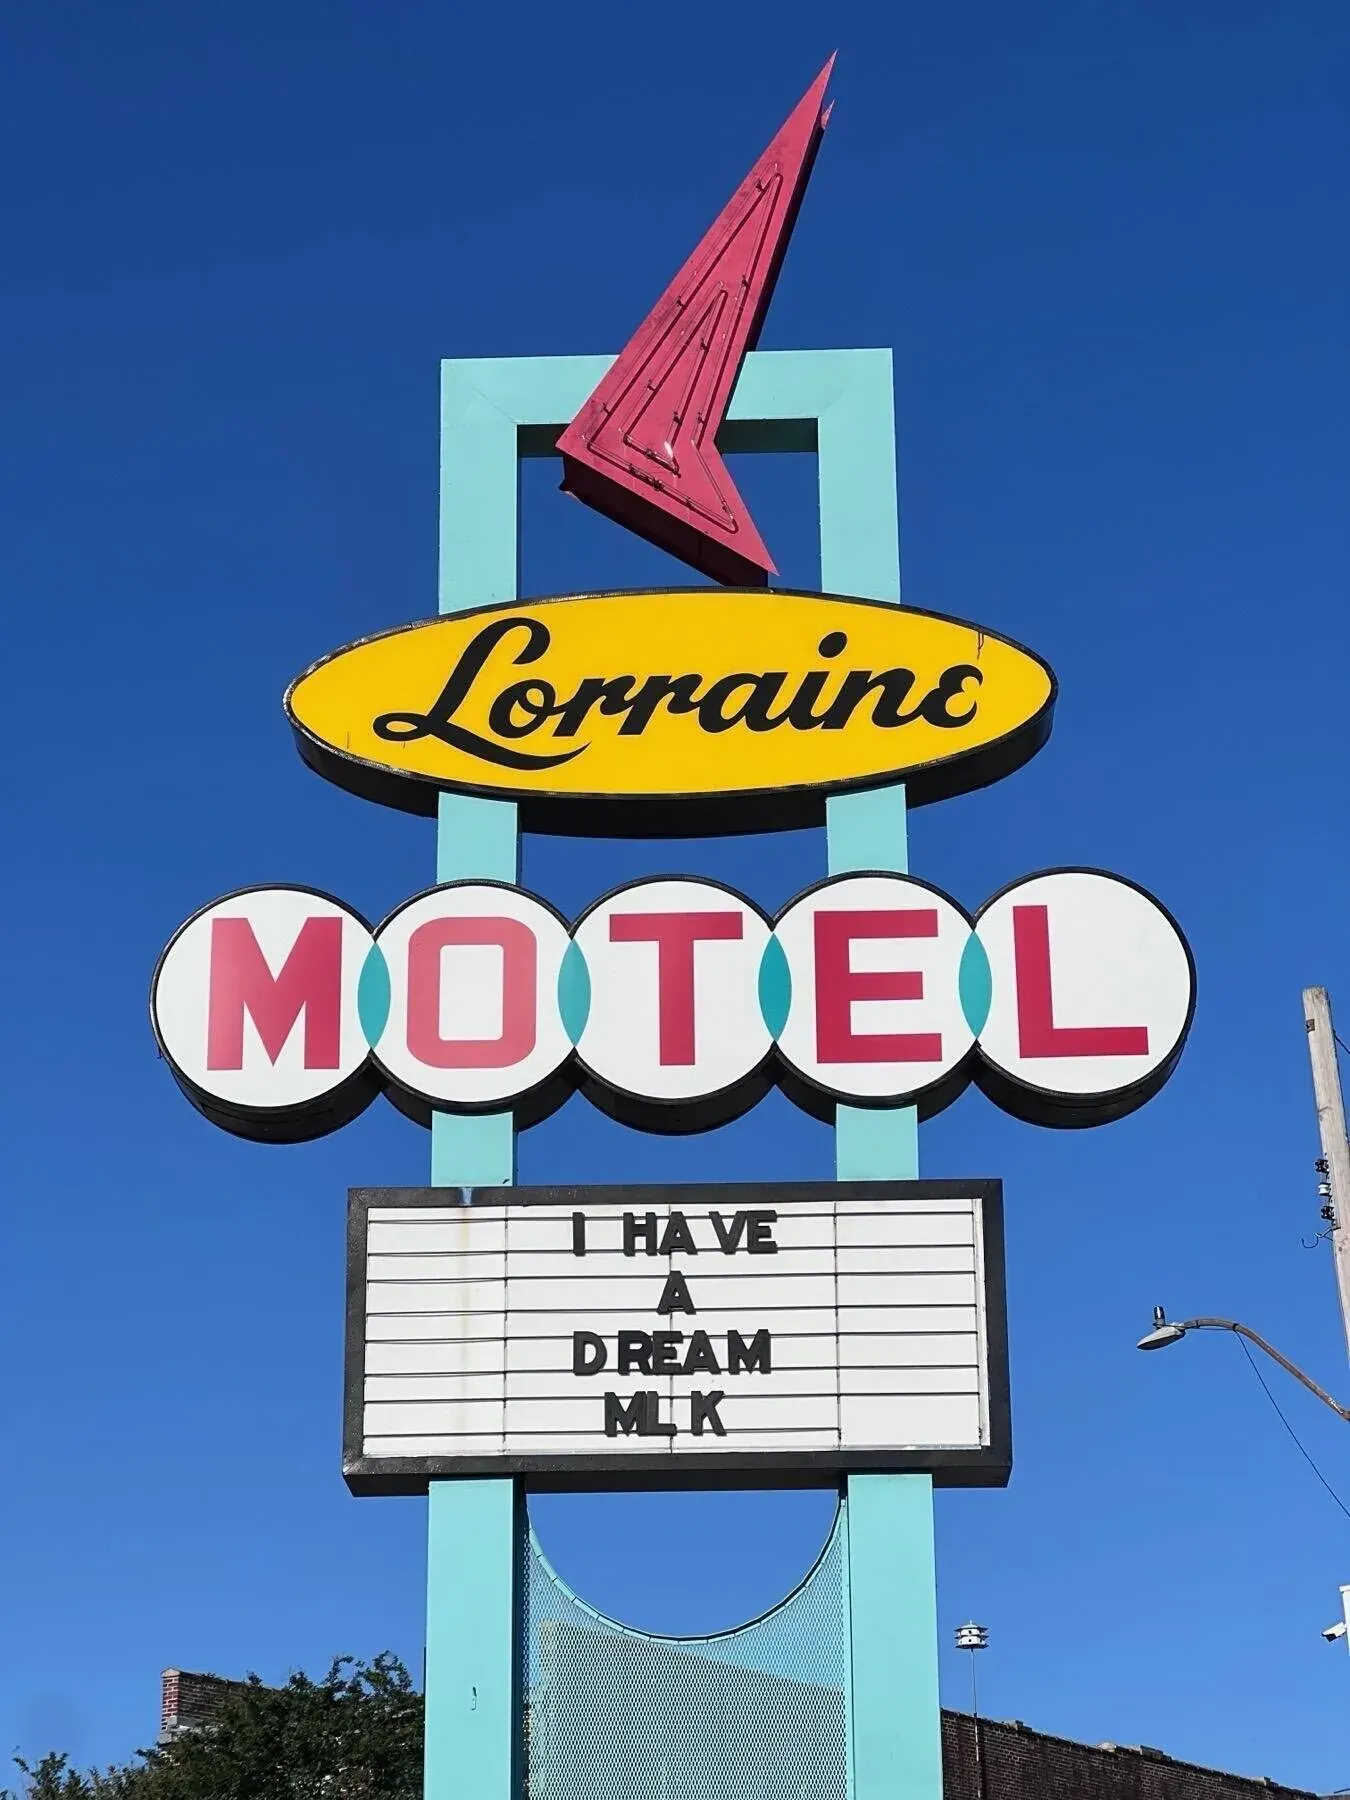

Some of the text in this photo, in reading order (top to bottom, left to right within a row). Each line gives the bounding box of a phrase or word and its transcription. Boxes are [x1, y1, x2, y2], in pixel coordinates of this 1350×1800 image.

[373, 616, 983, 770] Lorraine
[208, 905, 1148, 1069] MOTEL
[572, 1210, 778, 1256] I HAVE
[657, 1270, 696, 1315] A
[572, 1328, 771, 1376] DREAM
[604, 1390, 726, 1437] MLK
